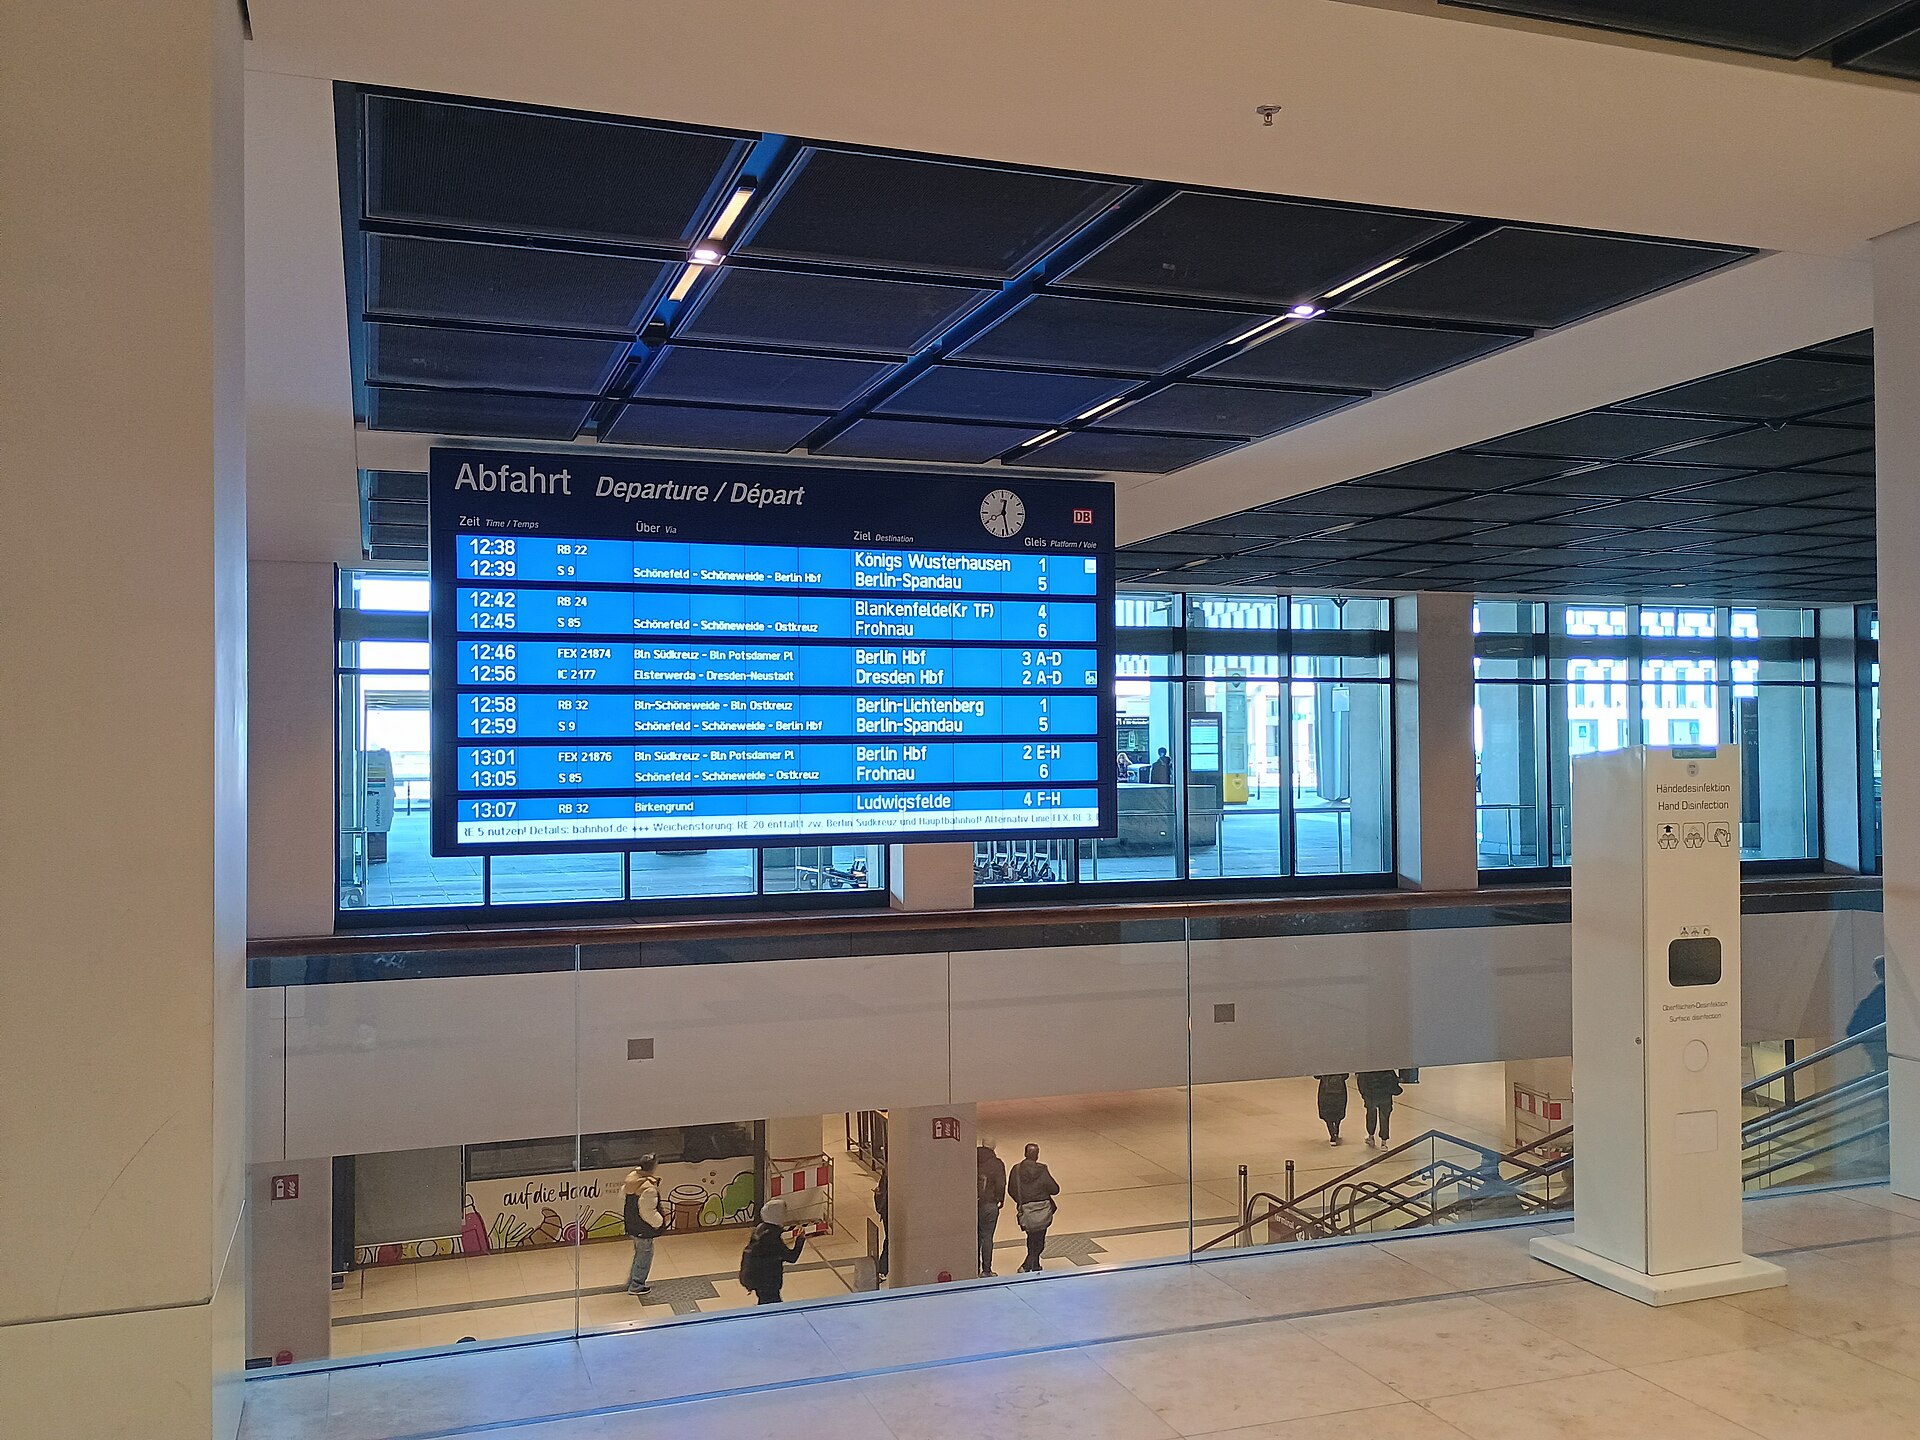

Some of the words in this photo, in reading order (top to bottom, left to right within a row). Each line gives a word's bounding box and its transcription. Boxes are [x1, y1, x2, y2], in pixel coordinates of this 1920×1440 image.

[454, 463, 571, 495] Abfahrt
[596, 476, 709, 502] Departure
[713, 482, 727, 501] /
[730, 482, 804, 508] Départ
[459, 516, 480, 527] Zeit
[485, 519, 505, 528] Time
[512, 520, 539, 530] Temps
[1074, 510, 1092, 523] DB
[636, 521, 660, 534] Über
[665, 526, 677, 534] Via
[854, 531, 871, 542] Ziel
[875, 534, 914, 543] Destination
[1024, 537, 1046, 548] Gleis
[1050, 540, 1078, 548] Platform
[1084, 541, 1097, 549] Voie
[470, 538, 516, 556] 12:38
[558, 544, 572, 554] RB
[574, 546, 588, 554] 22
[470, 560, 516, 576] 12:39
[856, 552, 902, 572] Königs
[908, 553, 1011, 573] Wusterhausen
[1038, 558, 1046, 572] 1
[558, 566, 564, 576] S
[568, 566, 574, 576] 9
[634, 568, 690, 578] Schönefeld
[700, 570, 764, 580] Schöneweide
[774, 572, 802, 582] Berlin
[804, 574, 822, 582] Hbf
[856, 572, 962, 592] Berlin-Spandau
[1038, 576, 1046, 590] 5
[470, 592, 516, 608] 12:42
[558, 596, 572, 606] RB
[574, 596, 588, 606] 24
[856, 600, 968, 618] Blankenfelde(Kr
[974, 604, 994, 618] TF)
[1038, 604, 1046, 618] 4
[470, 612, 516, 628] 12:45
[558, 618, 564, 628] S
[568, 618, 580, 628] 85
[634, 618, 690, 630] Schönefeld
[700, 620, 764, 630] Schöneweide
[774, 622, 818, 632] Ostkreuz
[856, 620, 914, 636] Frohnau
[1038, 624, 1048, 638] 6
[470, 644, 516, 660] 12:46
[558, 648, 578, 658] FEX
[580, 648, 610, 658] 21874
[634, 650, 650, 658] Bln
[654, 650, 700, 660] Südkreuz
[710, 650, 726, 660] Bln
[728, 650, 780, 660] Potsdamer
[784, 652, 794, 660] Pl
[856, 650, 896, 664] Berlin
[902, 650, 926, 664] Hbf
[1022, 652, 1032, 666] 3
[1036, 652, 1062, 666] A-D
[470, 666, 516, 682] 12:56
[558, 670, 568, 680] IC
[570, 670, 596, 680] 2177
[634, 670, 696, 680] Elsterwerda
[706, 670, 794, 680] Dresden-Neustadt
[856, 668, 914, 684] Dresden
[920, 670, 944, 684] Hbf
[1022, 670, 1032, 684] 2
[1036, 670, 1062, 684] A-D
[470, 696, 516, 712] 12:58
[558, 700, 572, 710] RB
[576, 700, 588, 710] 32
[634, 700, 720, 710] Bln-Schöneweide
[730, 700, 746, 710] Bln
[750, 700, 792, 710] Ostkreuz
[856, 698, 984, 716] Berlin-Lichtenberg
[1040, 698, 1046, 712] 1
[470, 718, 516, 734] 12:59
[558, 722, 566, 732] S
[568, 722, 576, 730] 9
[634, 722, 690, 730] Schönefeld
[702, 722, 766, 730] Schöneweide
[776, 720, 804, 730] Berlin
[806, 720, 822, 730] Hbf
[856, 718, 962, 736] Berlin-Spandau
[1040, 716, 1048, 732] 5
[472, 750, 514, 766] 13:01
[558, 752, 578, 762] FEX
[582, 752, 612, 762] 21876
[634, 752, 652, 762] Bln
[654, 752, 700, 760] Südkreuz
[710, 750, 726, 760] Bln
[730, 750, 782, 760] Potsdamer
[784, 750, 794, 760] Pl
[856, 746, 898, 762] Berlin
[904, 746, 926, 760] Hbf
[1024, 746, 1032, 760] 2
[1036, 744, 1060, 760] E-H
[472, 770, 516, 786] 13:05
[558, 774, 566, 782] S
[568, 774, 582, 782] 85
[634, 772, 690, 782] Schönefeld
[702, 772, 766, 780] Schöneweide
[776, 770, 820, 780] Ostkreuz
[856, 766, 914, 780] Frohnau
[1040, 764, 1048, 778] 6
[1656, 782, 1730, 794] Händedesinfektion
[856, 794, 952, 812] Ludwigsfelde
[1024, 792, 1032, 806] 4
[1038, 792, 1060, 806] F-H
[1658, 802, 1680, 810] Hand
[1682, 800, 1729, 810] Disinfection
[472, 802, 516, 818] 13:07
[558, 804, 572, 814] RB
[576, 804, 588, 814] 32
[634, 802, 694, 814] Birkengrund
[477, 827, 484, 835] 5
[529, 825, 568, 834] Details:
[572, 823, 628, 833] bahnhof.de
[736, 820, 748, 829] RE
[752, 820, 764, 828] 20
[826, 818, 852, 826] Berlin
[900, 817, 916, 825] und
[984, 814, 1028, 822] Alternativ
[504, 1182, 533, 1209] auf
[534, 1184, 556, 1203] die
[559, 1178, 600, 1201] Hand
